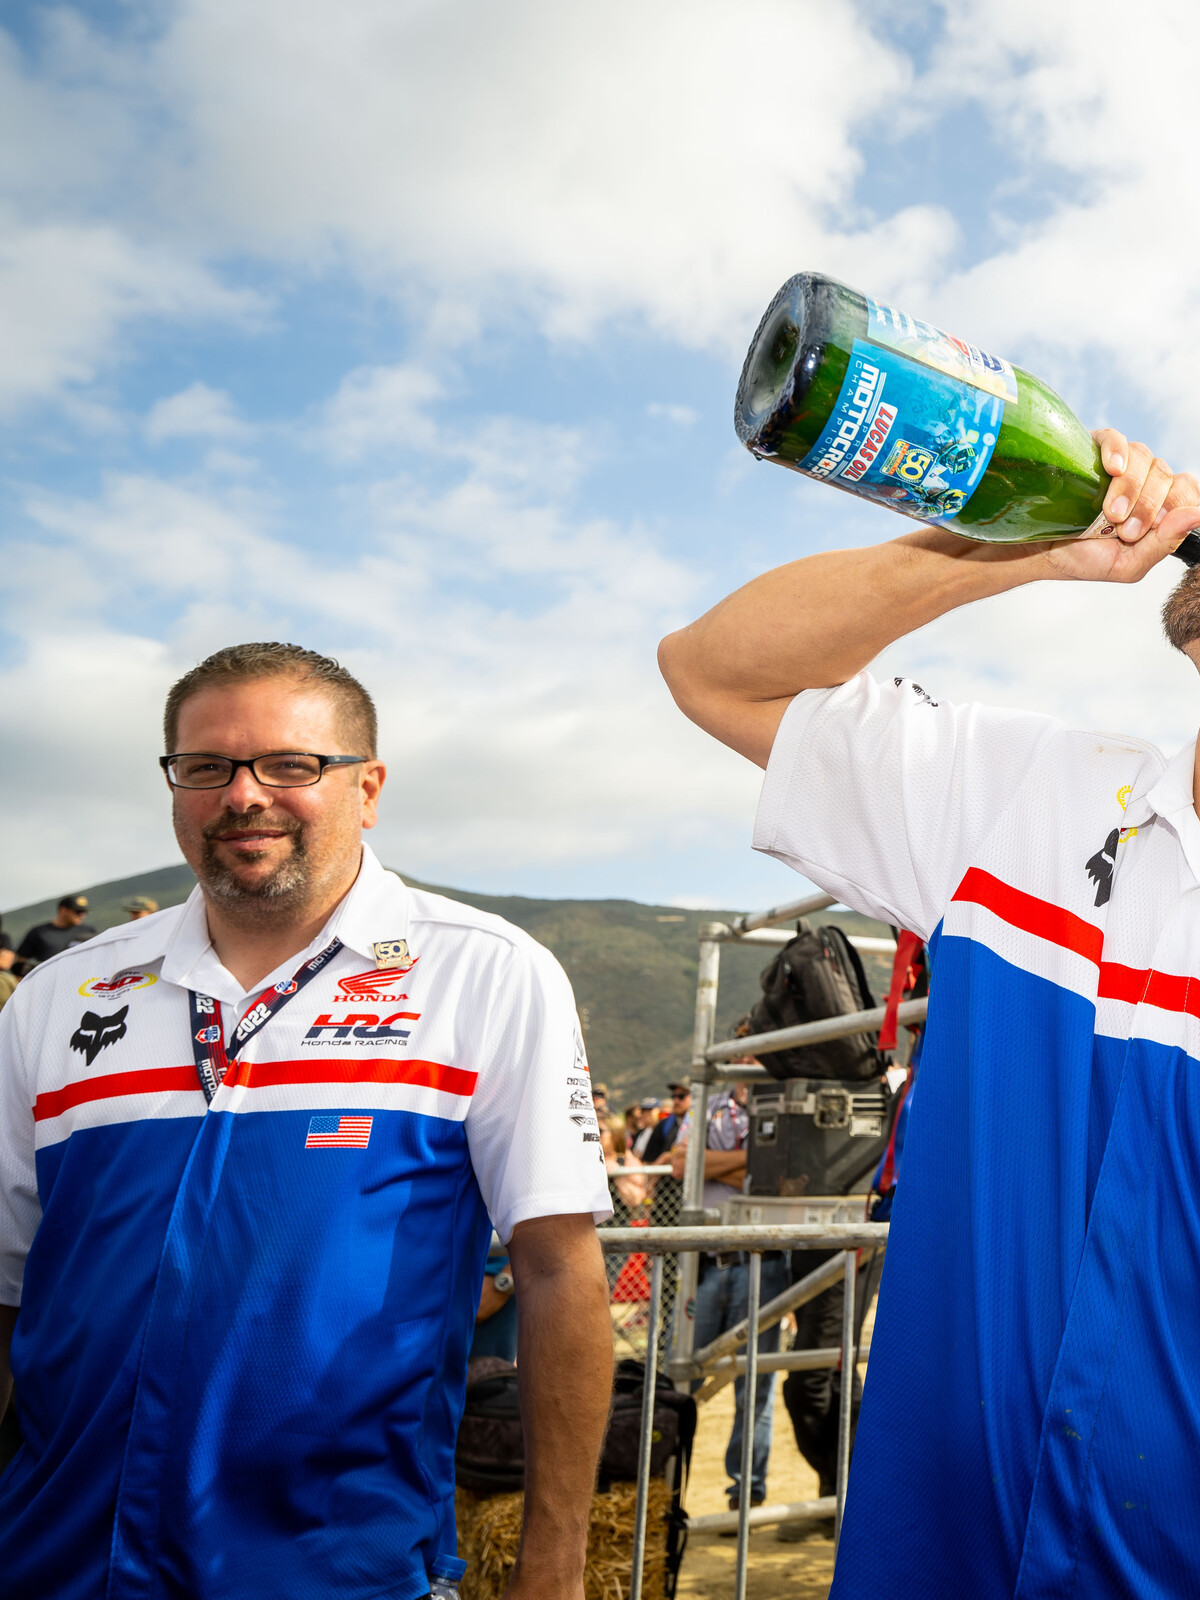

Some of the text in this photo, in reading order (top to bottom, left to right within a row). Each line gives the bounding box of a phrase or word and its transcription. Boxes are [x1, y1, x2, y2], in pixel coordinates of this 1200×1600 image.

[805, 363, 880, 480] MOTOCROSS
[844, 406, 894, 480] LUCAS OIL
[900, 451, 931, 480] 50
[331, 993, 410, 1003] HONDA
[236, 1002, 272, 1042] 2022
[304, 1011, 422, 1039] HRC
[354, 1039, 408, 1047] RACING
